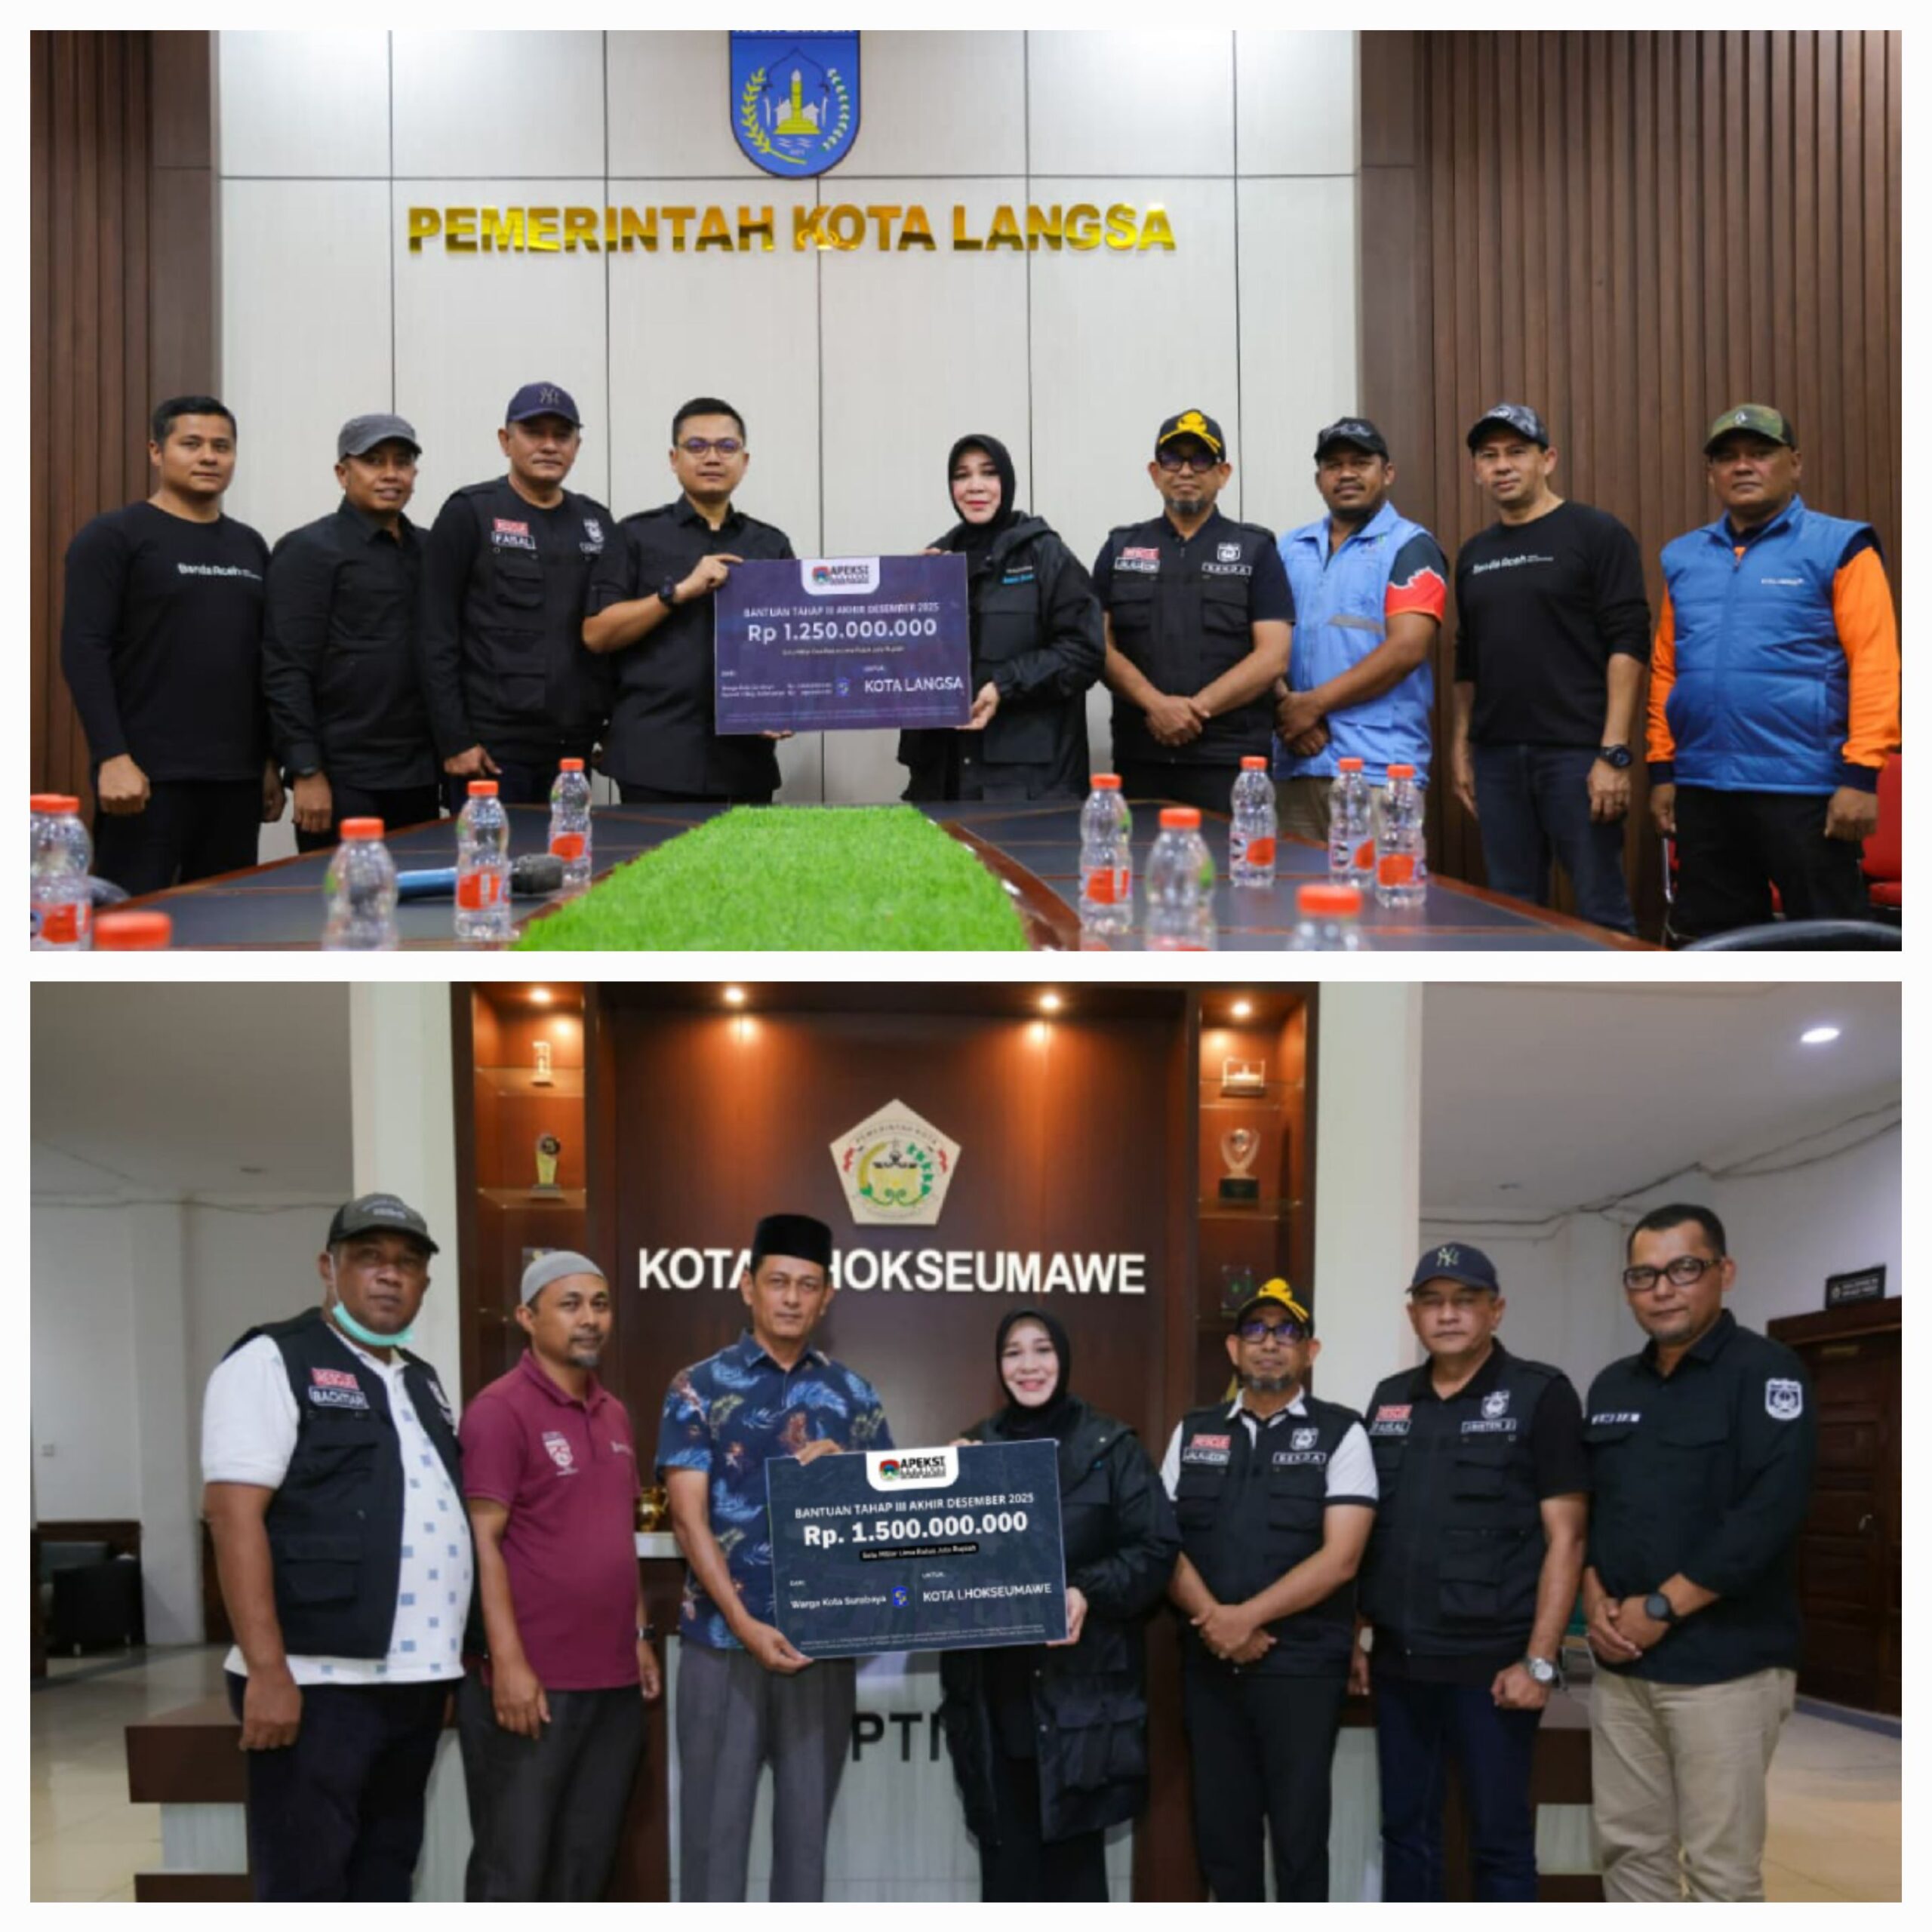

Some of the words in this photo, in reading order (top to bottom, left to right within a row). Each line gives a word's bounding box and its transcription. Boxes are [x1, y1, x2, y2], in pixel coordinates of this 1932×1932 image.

[408, 206, 774, 253] PEMERINTAH
[792, 203, 937, 251] KOTA
[952, 202, 1176, 251] LANGSA
[747, 624, 777, 645] Rp
[783, 617, 937, 641] 1.250.000.000
[865, 678, 902, 693] KOTA
[906, 676, 964, 692] LANGSA
[828, 1248, 1146, 1294] HOKSEUMAWE
[900, 1455, 946, 1469] APEKSI
[795, 1505, 852, 1519] BANTUAN
[854, 1501, 894, 1515] TAHAP
[909, 1498, 944, 1511] AKHIR
[946, 1494, 1006, 1509] DESEMBER
[1008, 1492, 1034, 1504] 2025
[804, 1524, 845, 1549] Rp.
[851, 1511, 1028, 1543] 1.500.000.000
[923, 1589, 955, 1602] KOTA
[957, 1583, 1052, 1601] LHOKSEUMAWE
